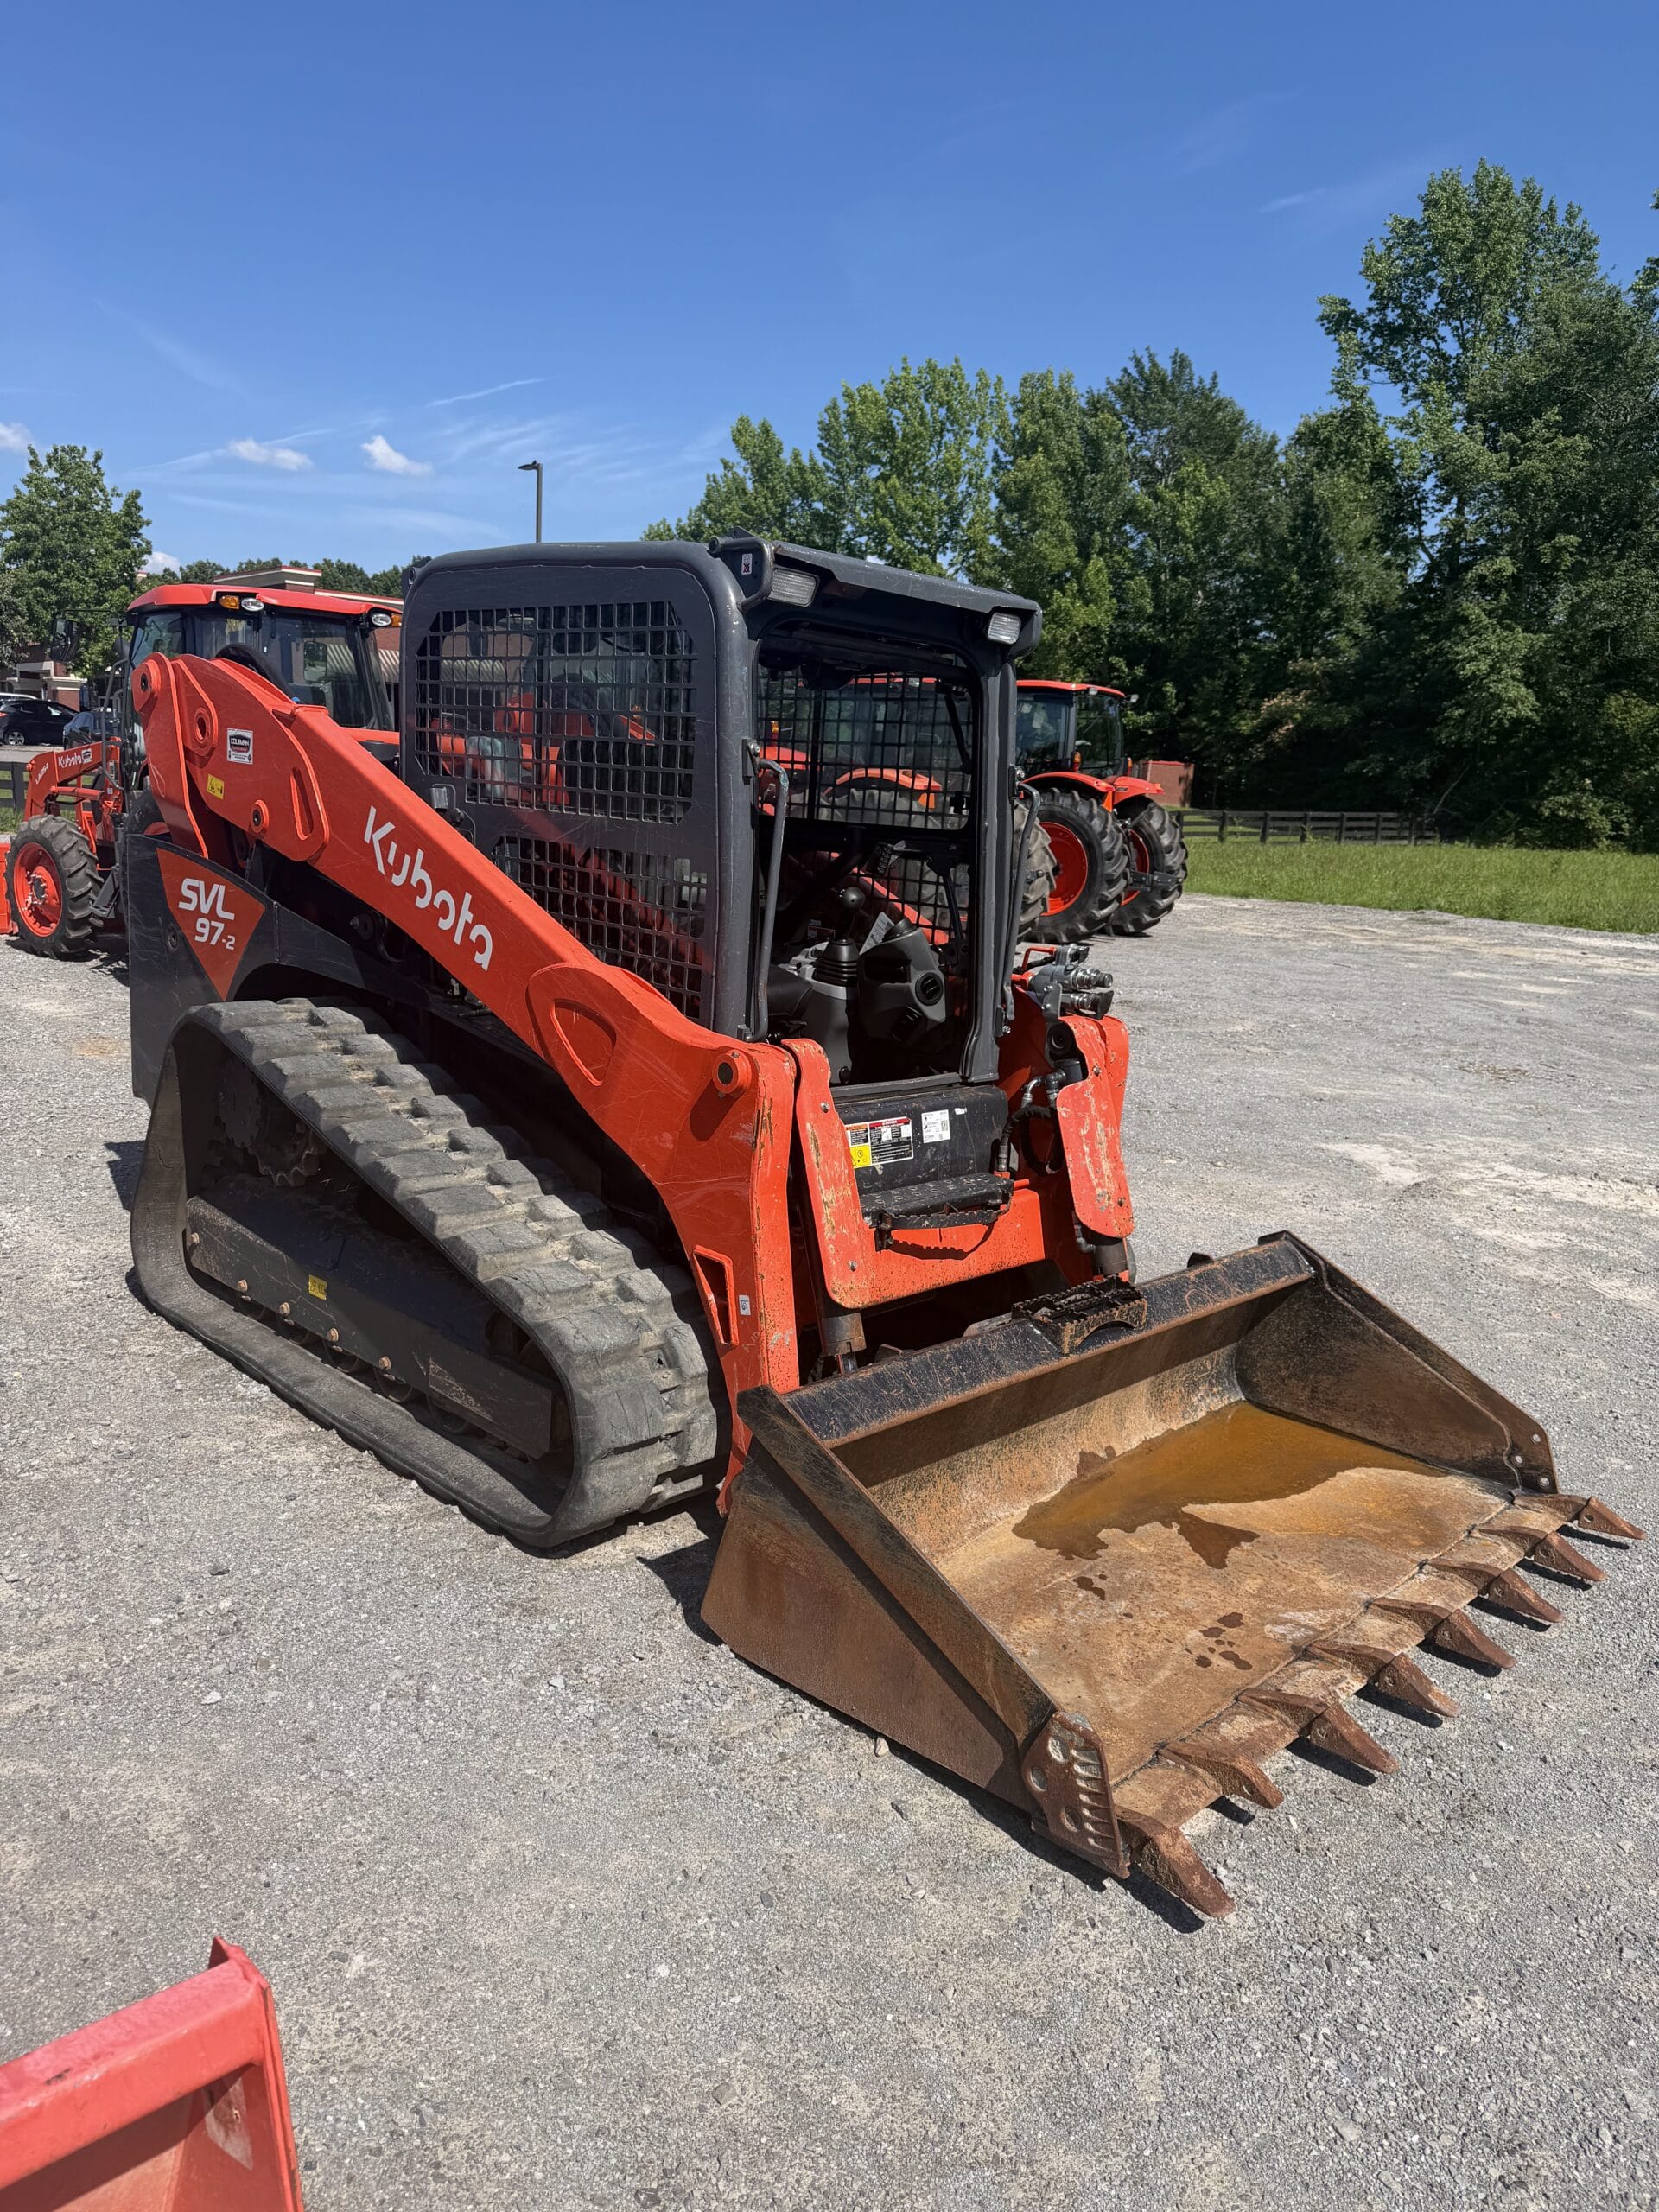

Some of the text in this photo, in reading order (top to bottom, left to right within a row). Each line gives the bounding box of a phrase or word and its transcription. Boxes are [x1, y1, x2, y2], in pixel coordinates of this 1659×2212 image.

[58, 753, 82, 768] Kubota
[178, 878, 235, 920] SVL
[364, 805, 493, 971] Kubota
[194, 918, 236, 950] 97-2
